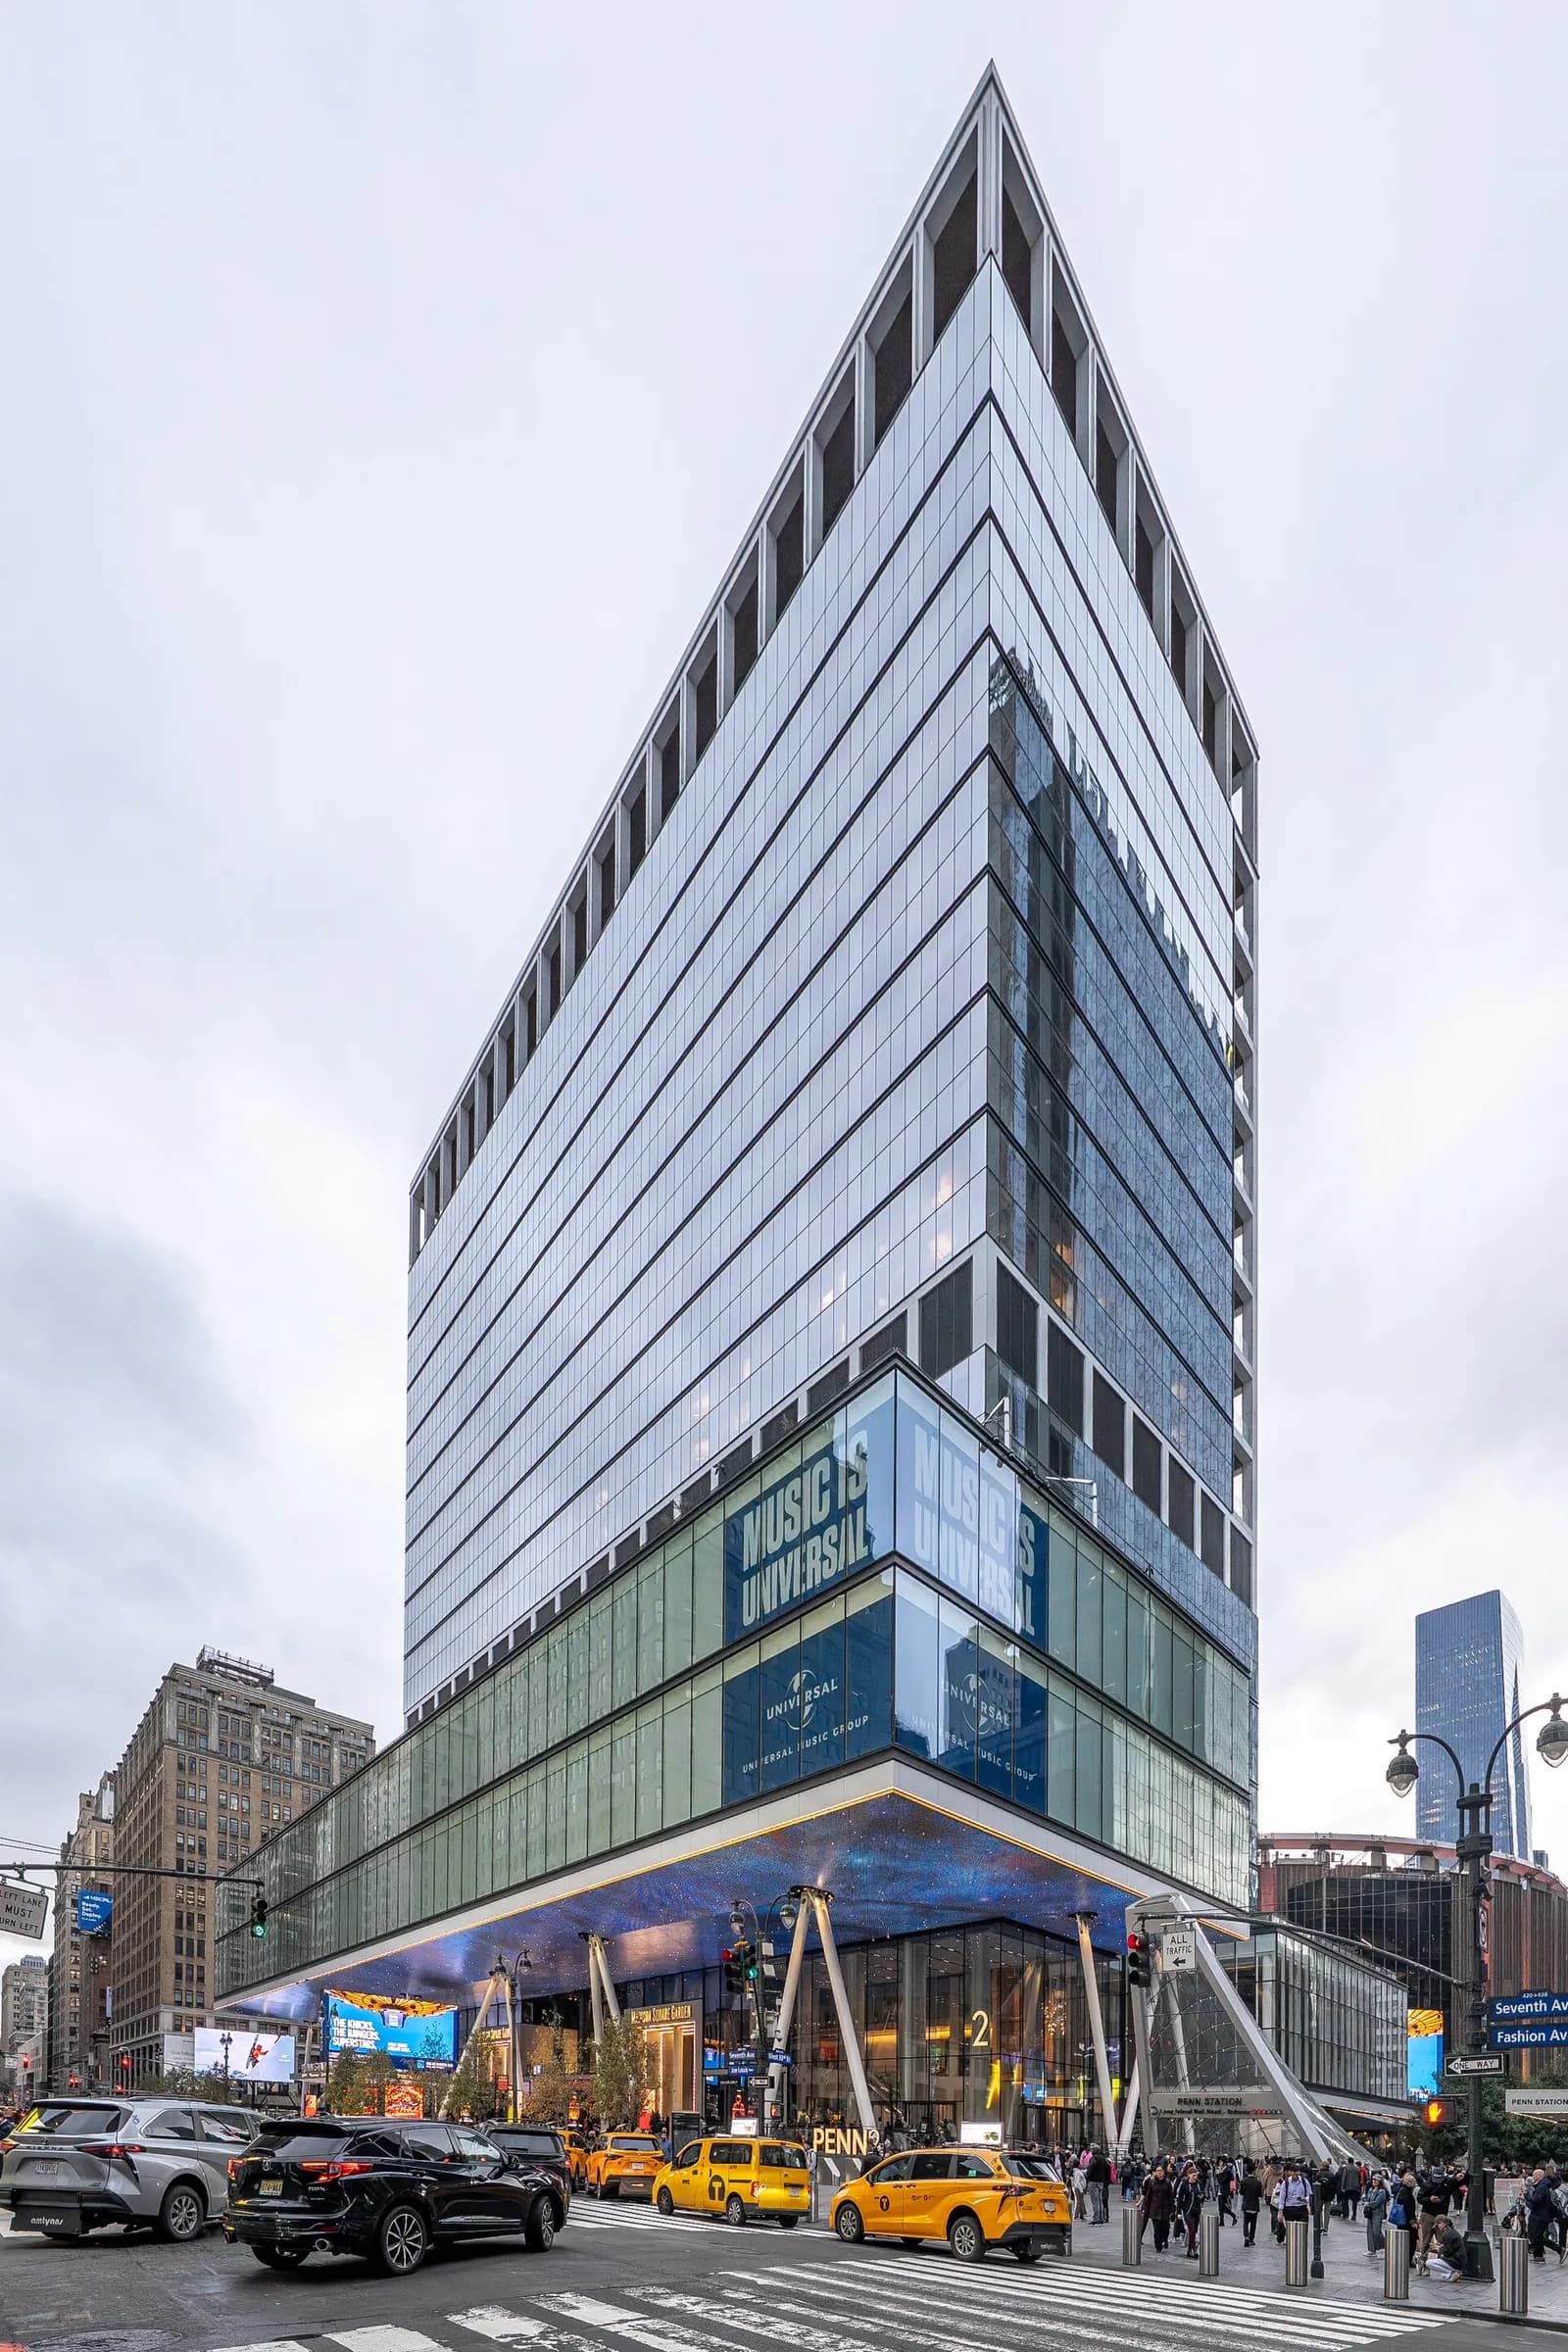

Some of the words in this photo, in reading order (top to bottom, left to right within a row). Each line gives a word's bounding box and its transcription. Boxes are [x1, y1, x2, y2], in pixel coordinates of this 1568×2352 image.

[915, 1423, 1005, 1554] MUSIC
[743, 1456, 831, 1572] MUSIC
[838, 1430, 868, 1509] IS
[743, 1505, 868, 1627] UNIVERSAL
[1005, 1762, 1034, 1781] GOUP
[22, 1896, 43, 1908] LANE
[5, 1904, 33, 1919] MUST
[20, 1922, 38, 1934] LEFT
[1170, 1935, 1188, 1945] ALL
[1166, 1945, 1193, 1956] TRAFFIC
[1495, 1999, 1547, 2015] Seventh
[972, 2010, 989, 2047] 2
[1497, 2030, 1545, 2043] Fashion
[1454, 2061, 1469, 2070] ONE
[1477, 2060, 1494, 2069] WAY
[1177, 2097, 1201, 2106] PENN
[1203, 2097, 1243, 2106] STATION
